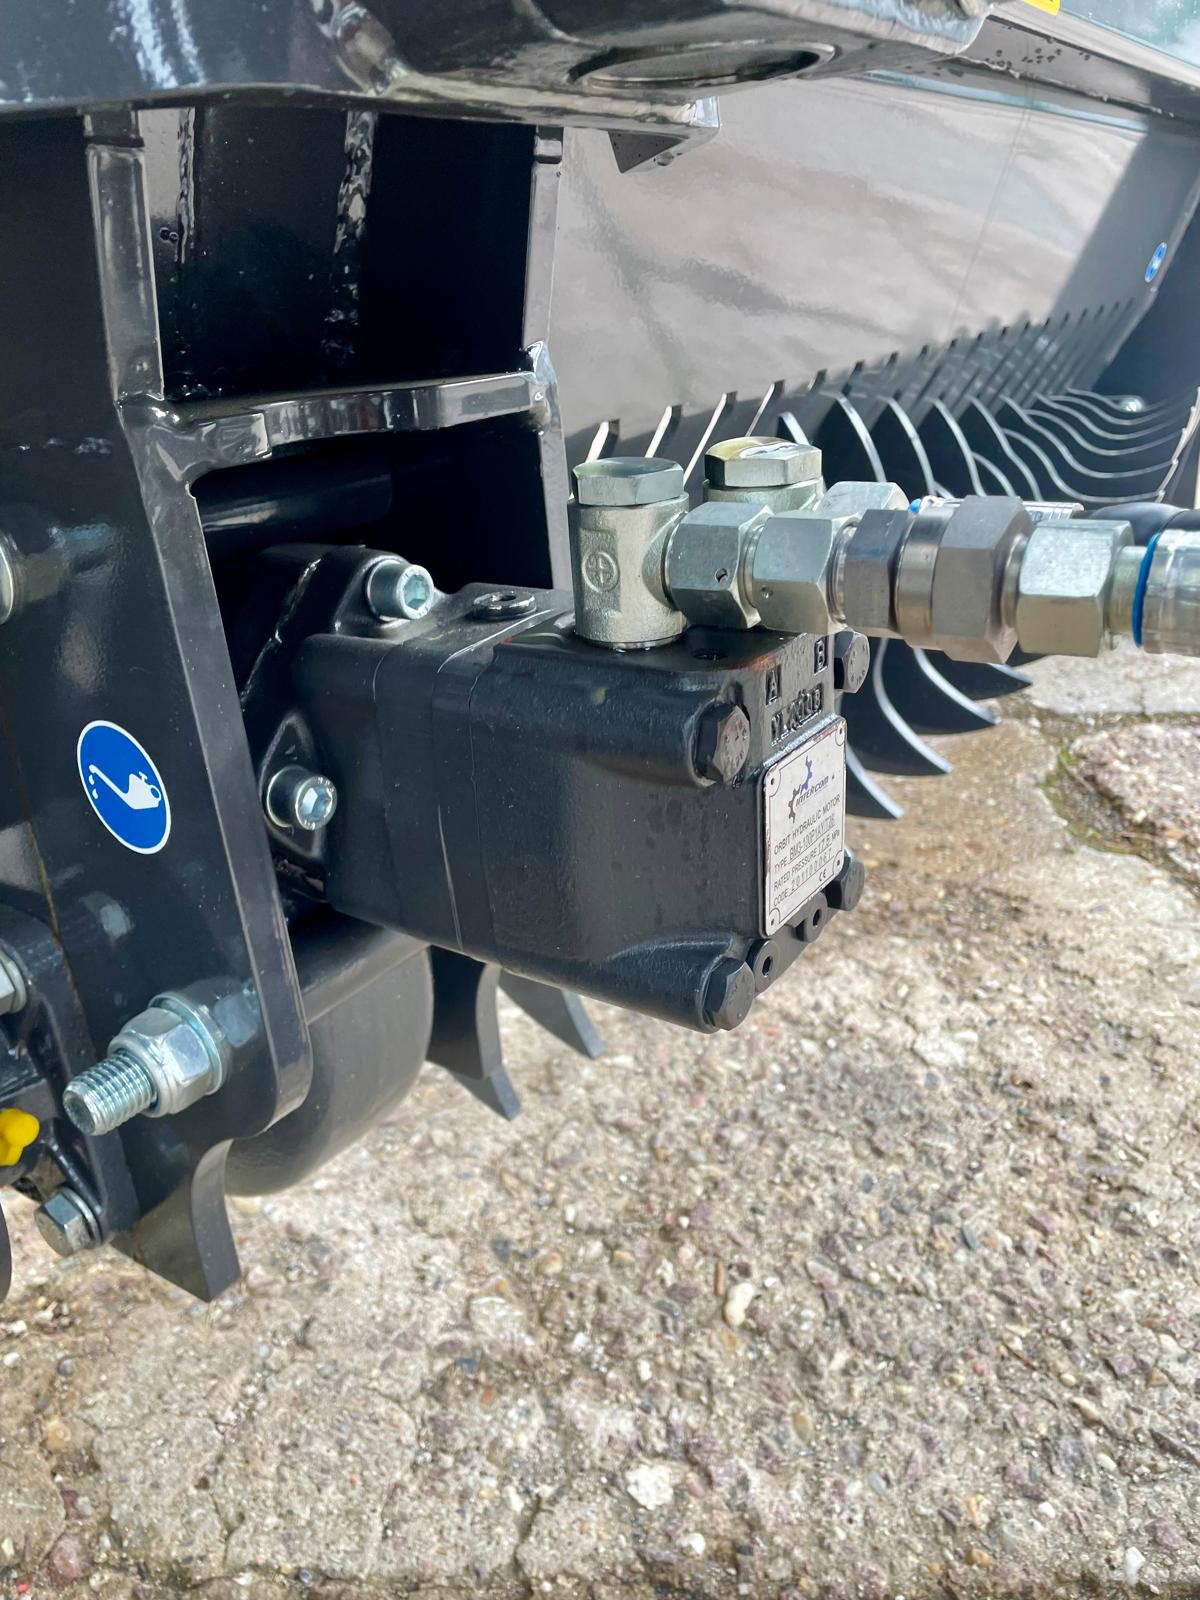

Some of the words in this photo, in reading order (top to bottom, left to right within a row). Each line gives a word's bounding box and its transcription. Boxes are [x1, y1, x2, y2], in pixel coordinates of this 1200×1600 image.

[766, 665, 782, 706] A
[773, 834, 791, 856] ORBIT
[792, 809, 821, 840] HYDRAULIC
[822, 794, 841, 815] MOTOR
[773, 870, 791, 892] RATED
[791, 847, 818, 878] PRESSURE
